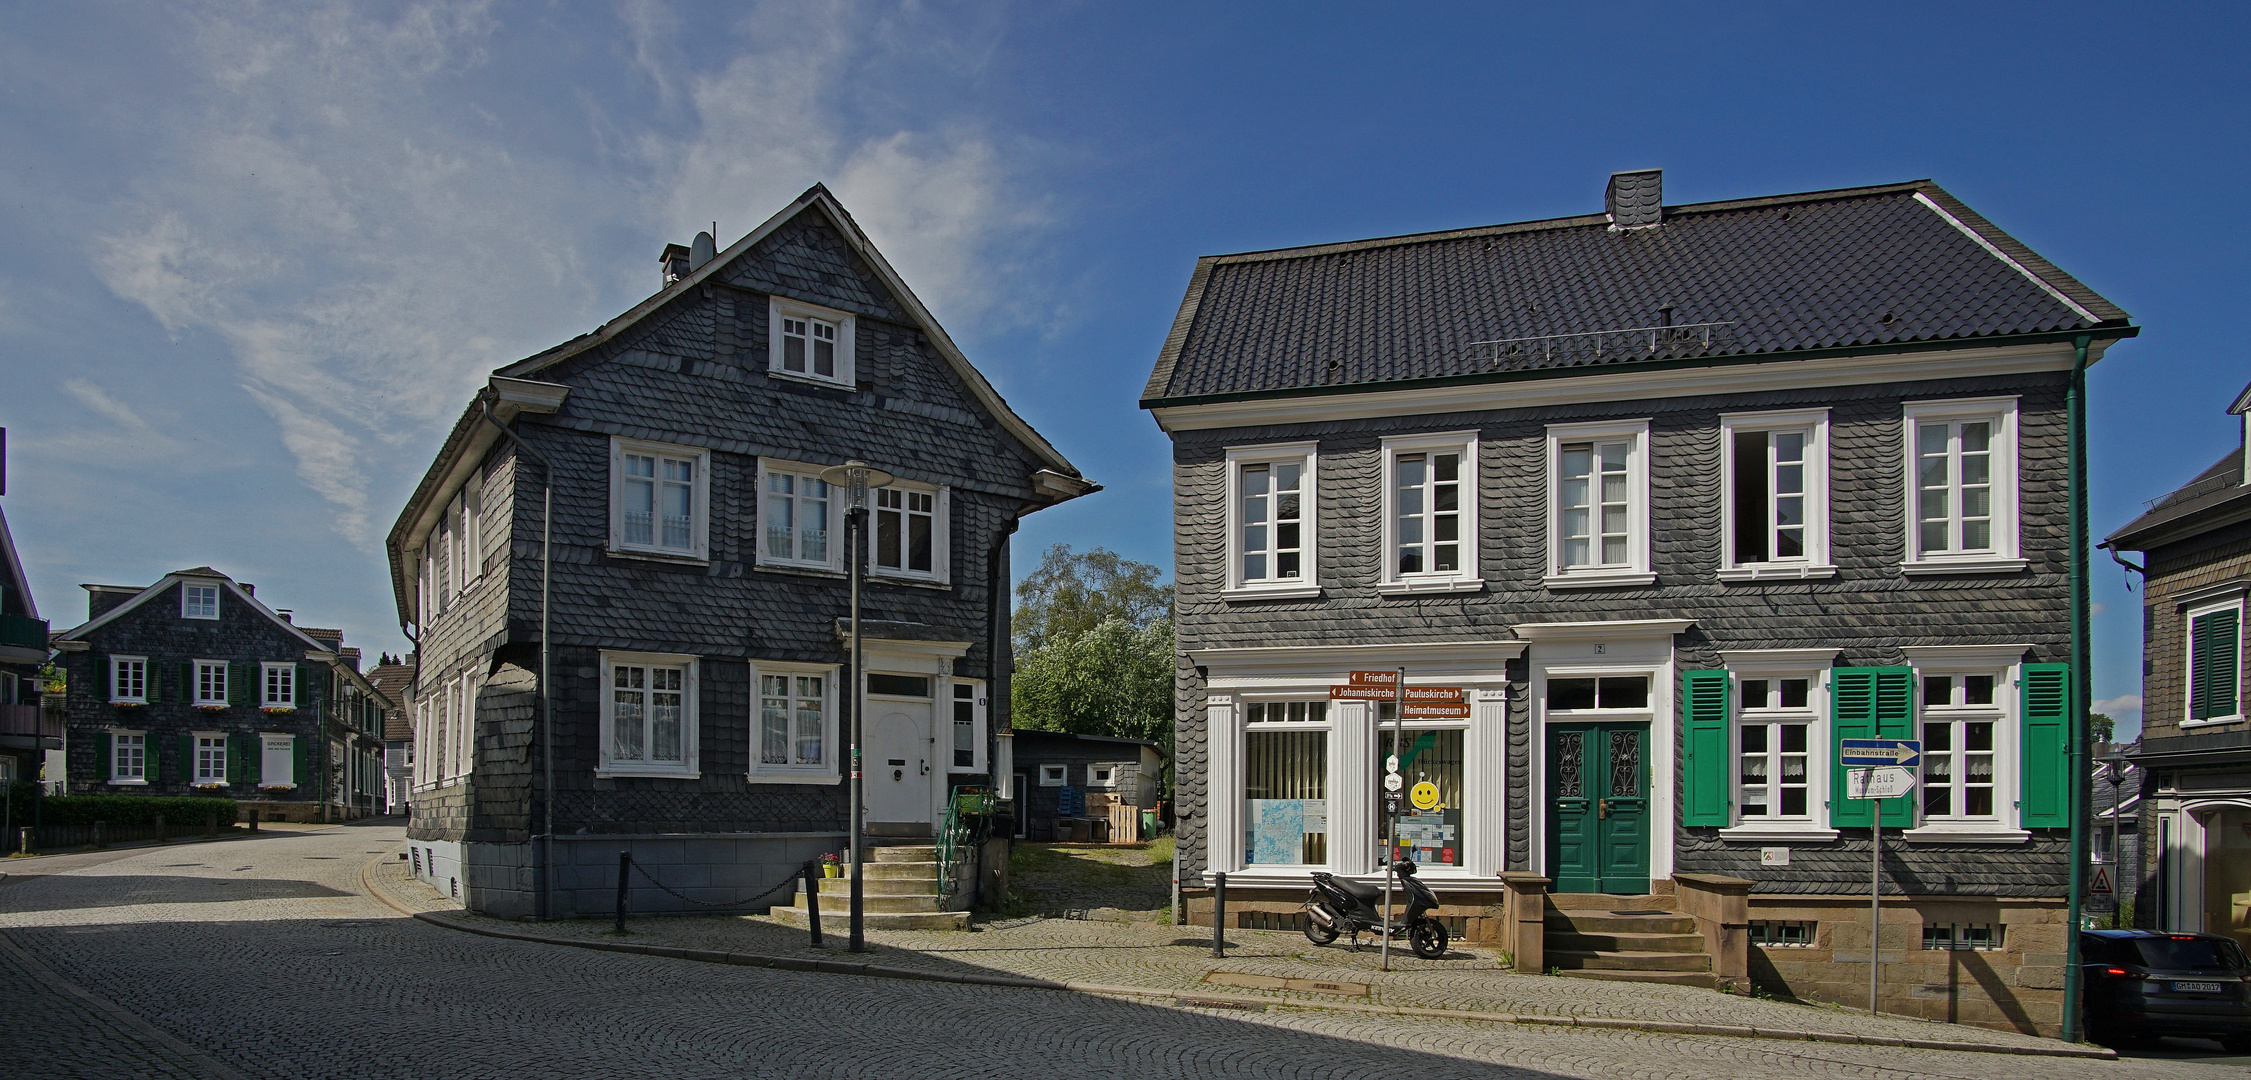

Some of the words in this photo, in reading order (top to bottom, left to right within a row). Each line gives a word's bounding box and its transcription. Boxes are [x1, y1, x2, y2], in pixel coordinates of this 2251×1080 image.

[1597, 645, 1603, 653] 2
[1364, 673, 1396, 683] Friedhof
[1339, 687, 1395, 698] Johanniskirche
[1405, 688, 1453, 699] Pauluskirche
[1404, 705, 1461, 715] Heimatmuseum
[1844, 749, 1899, 757] Einbahnstraße
[1853, 773, 1895, 784] Rathaus
[2176, 982, 2187, 990] GM
[2201, 983, 2220, 991] 2017
